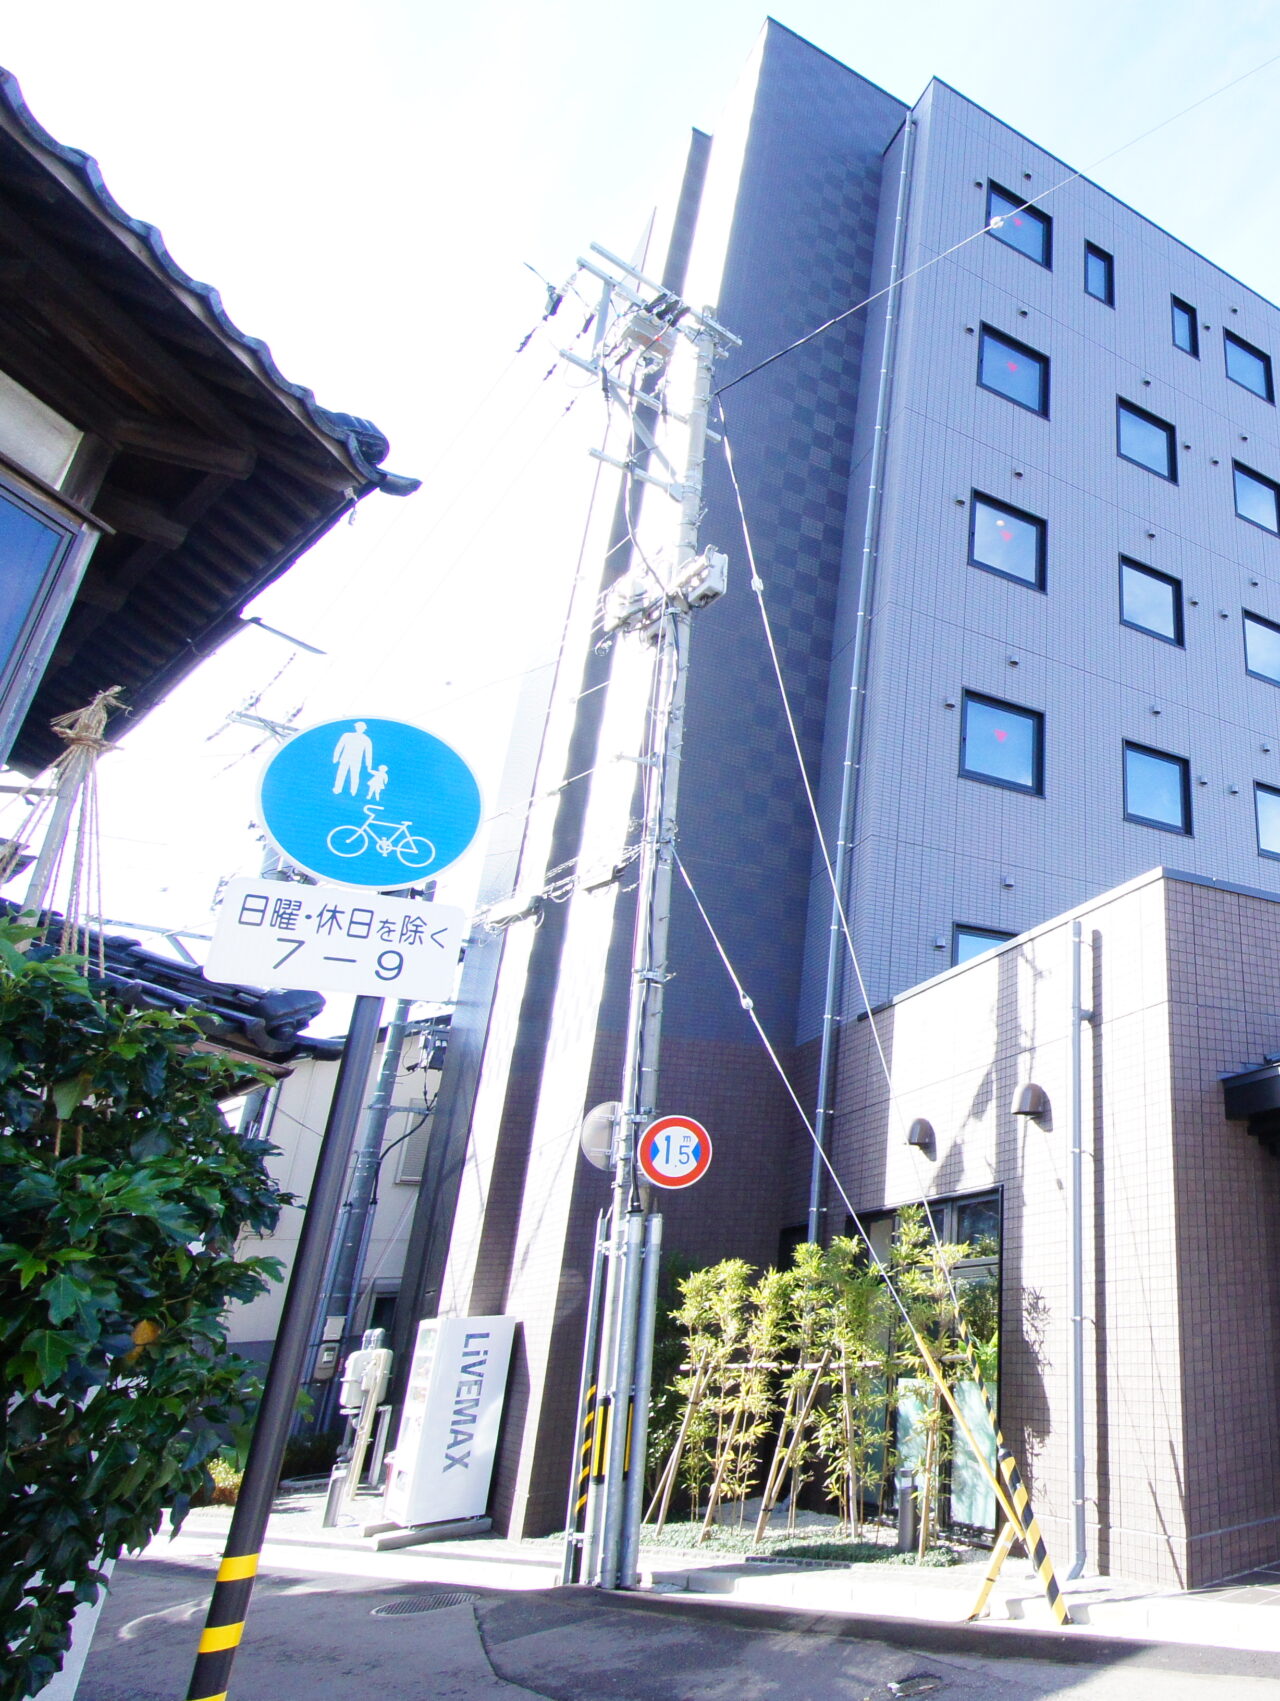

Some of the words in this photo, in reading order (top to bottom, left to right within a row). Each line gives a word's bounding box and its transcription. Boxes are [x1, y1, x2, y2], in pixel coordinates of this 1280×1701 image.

[237, 893, 449, 949] 日曜・休日を除く
